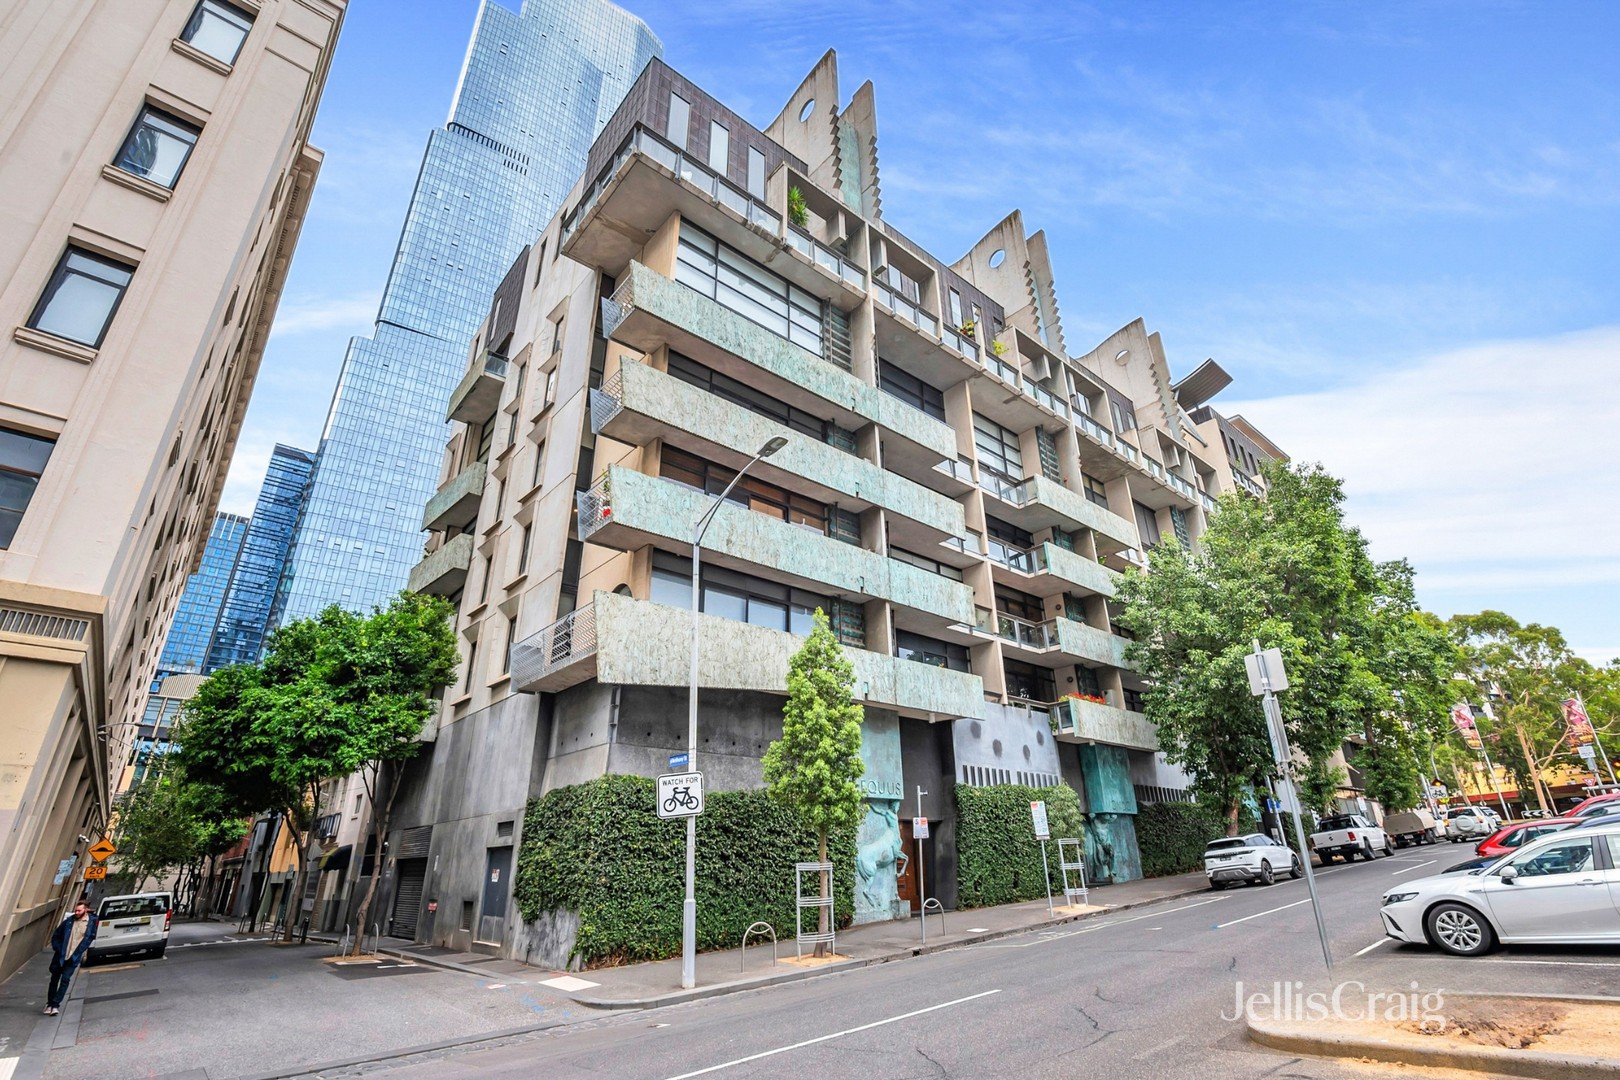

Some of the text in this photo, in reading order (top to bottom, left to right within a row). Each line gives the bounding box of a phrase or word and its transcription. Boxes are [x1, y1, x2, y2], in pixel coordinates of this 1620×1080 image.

[662, 776, 699, 786] WATCH FOR
[860, 779, 902, 796] EQUUS
[89, 867, 104, 875] 20
